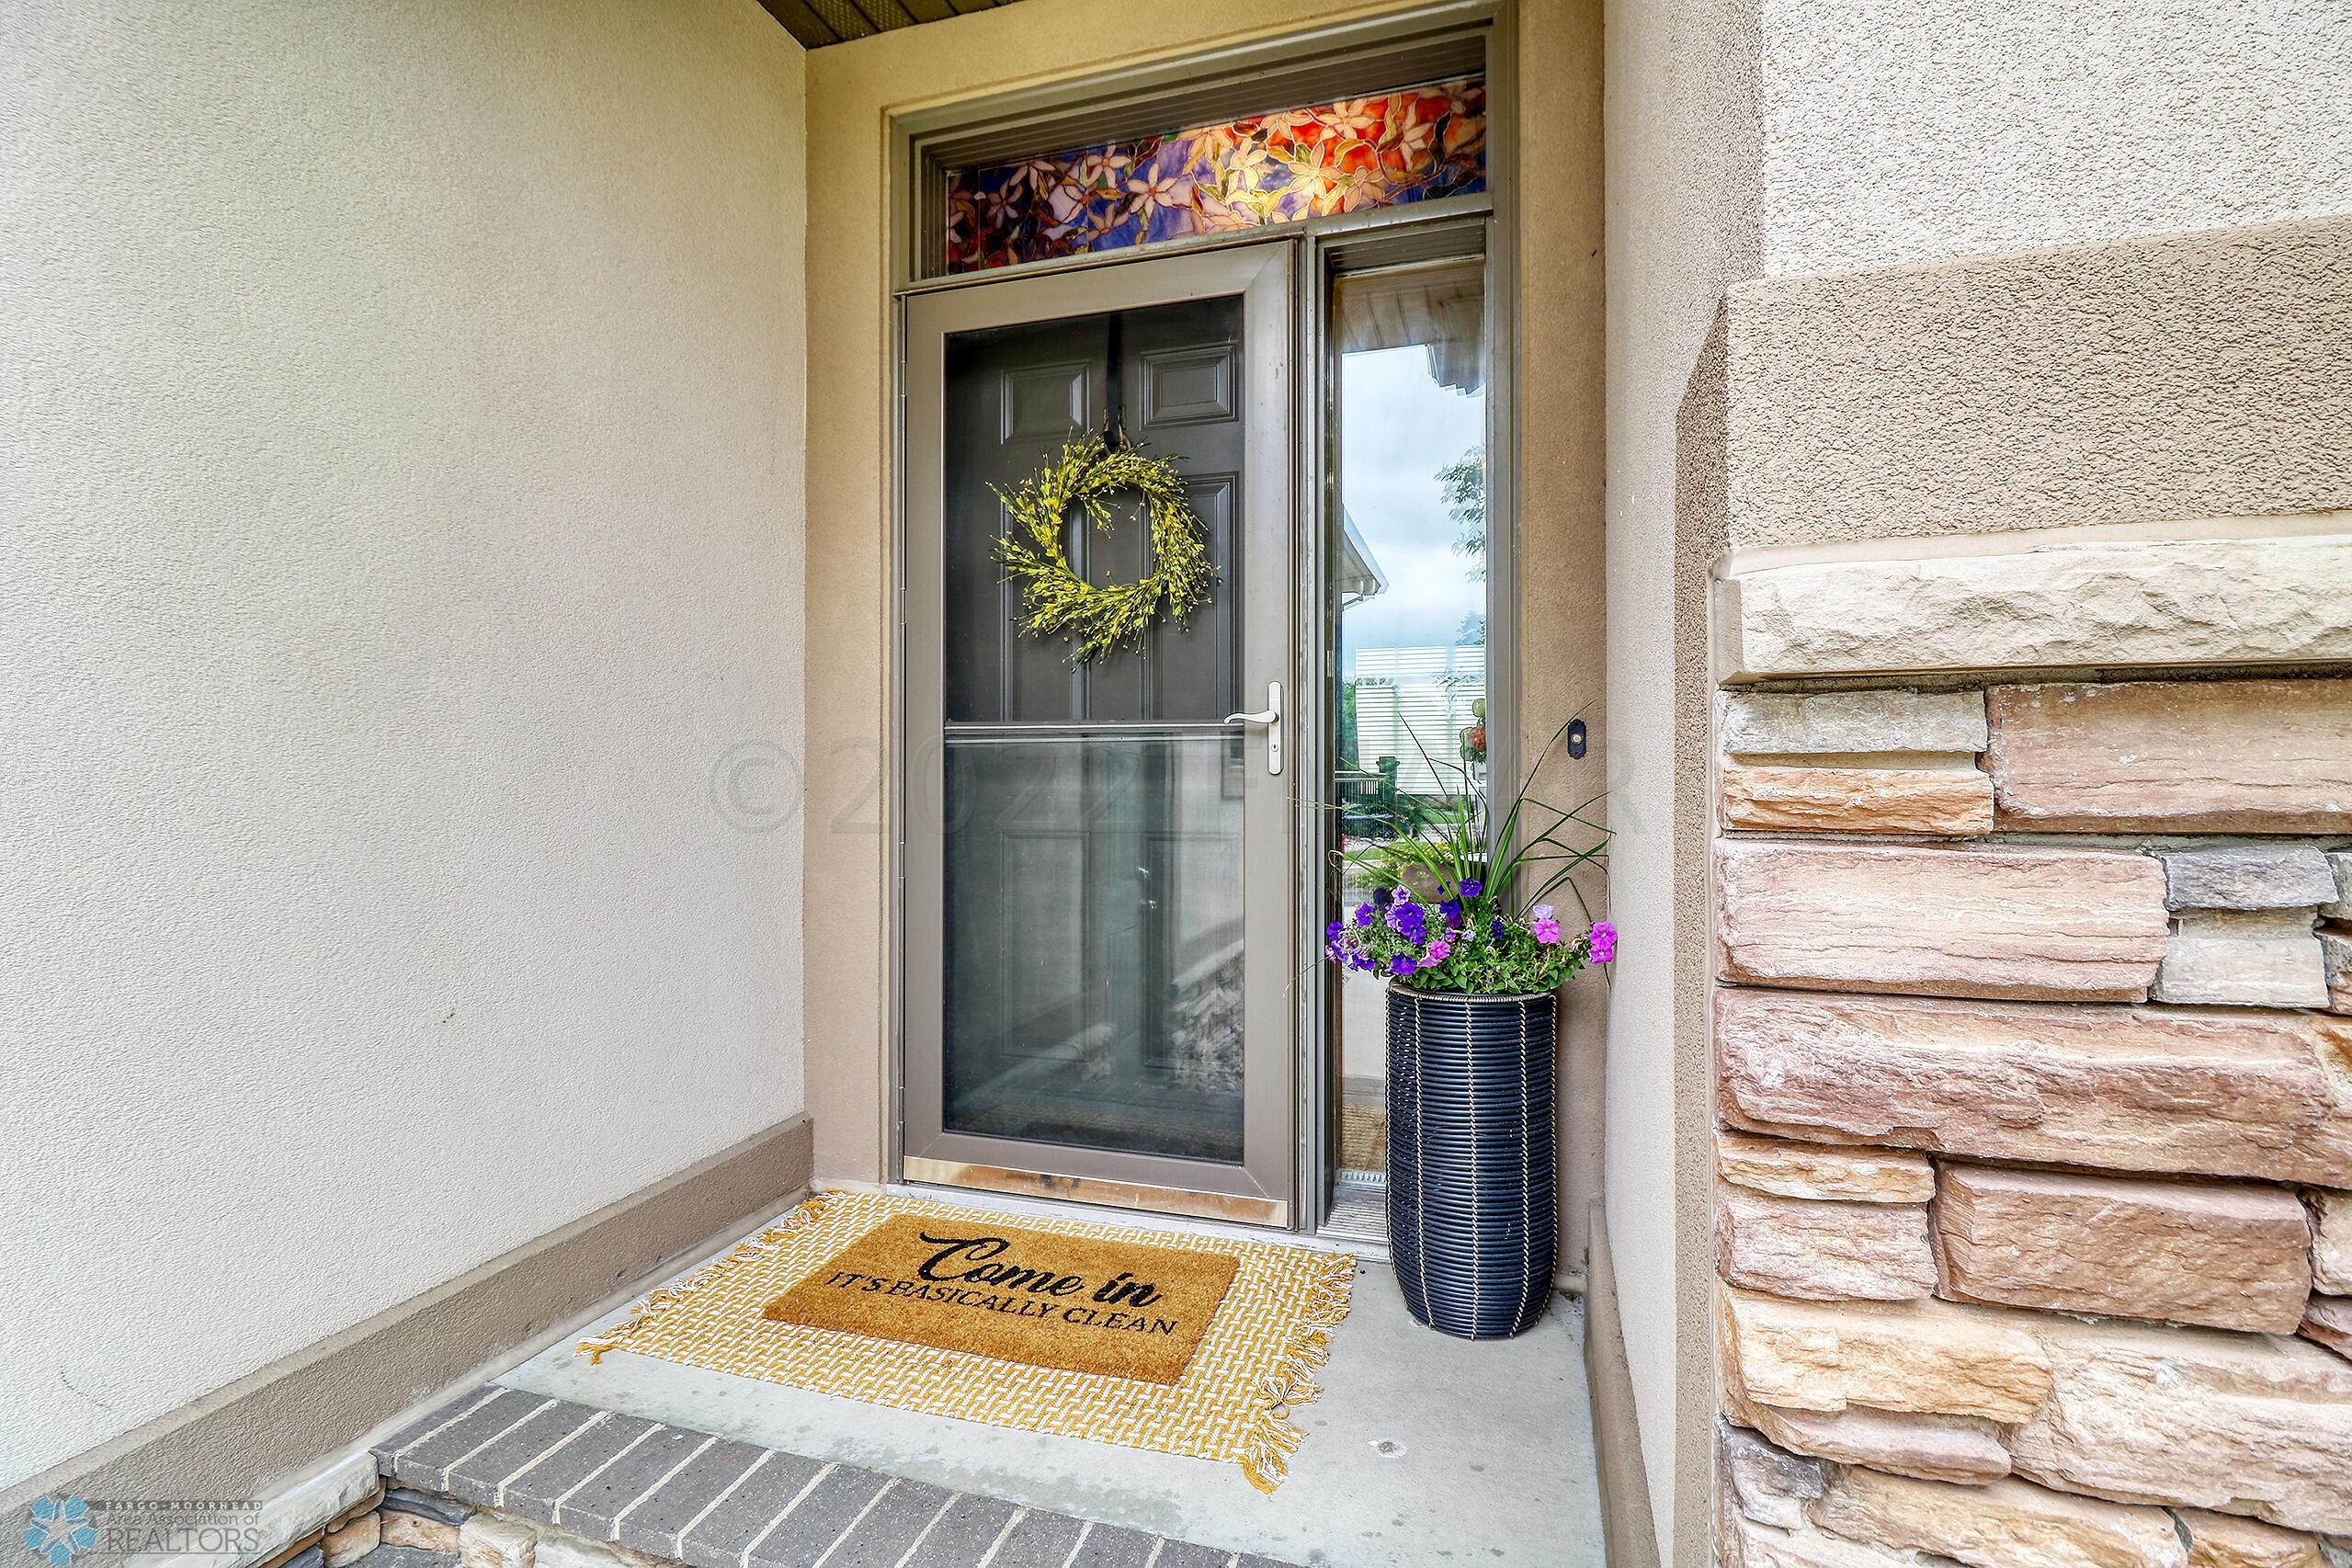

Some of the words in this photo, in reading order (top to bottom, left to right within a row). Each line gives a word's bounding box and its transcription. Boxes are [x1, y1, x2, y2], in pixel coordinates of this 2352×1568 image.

[825, 1272, 882, 1293] IT'S
[888, 1280, 1059, 1319] BASICALLY
[1063, 1306, 1178, 1335] CLEAN
[919, 1231, 1085, 1296] Come
[1093, 1272, 1164, 1307] in
